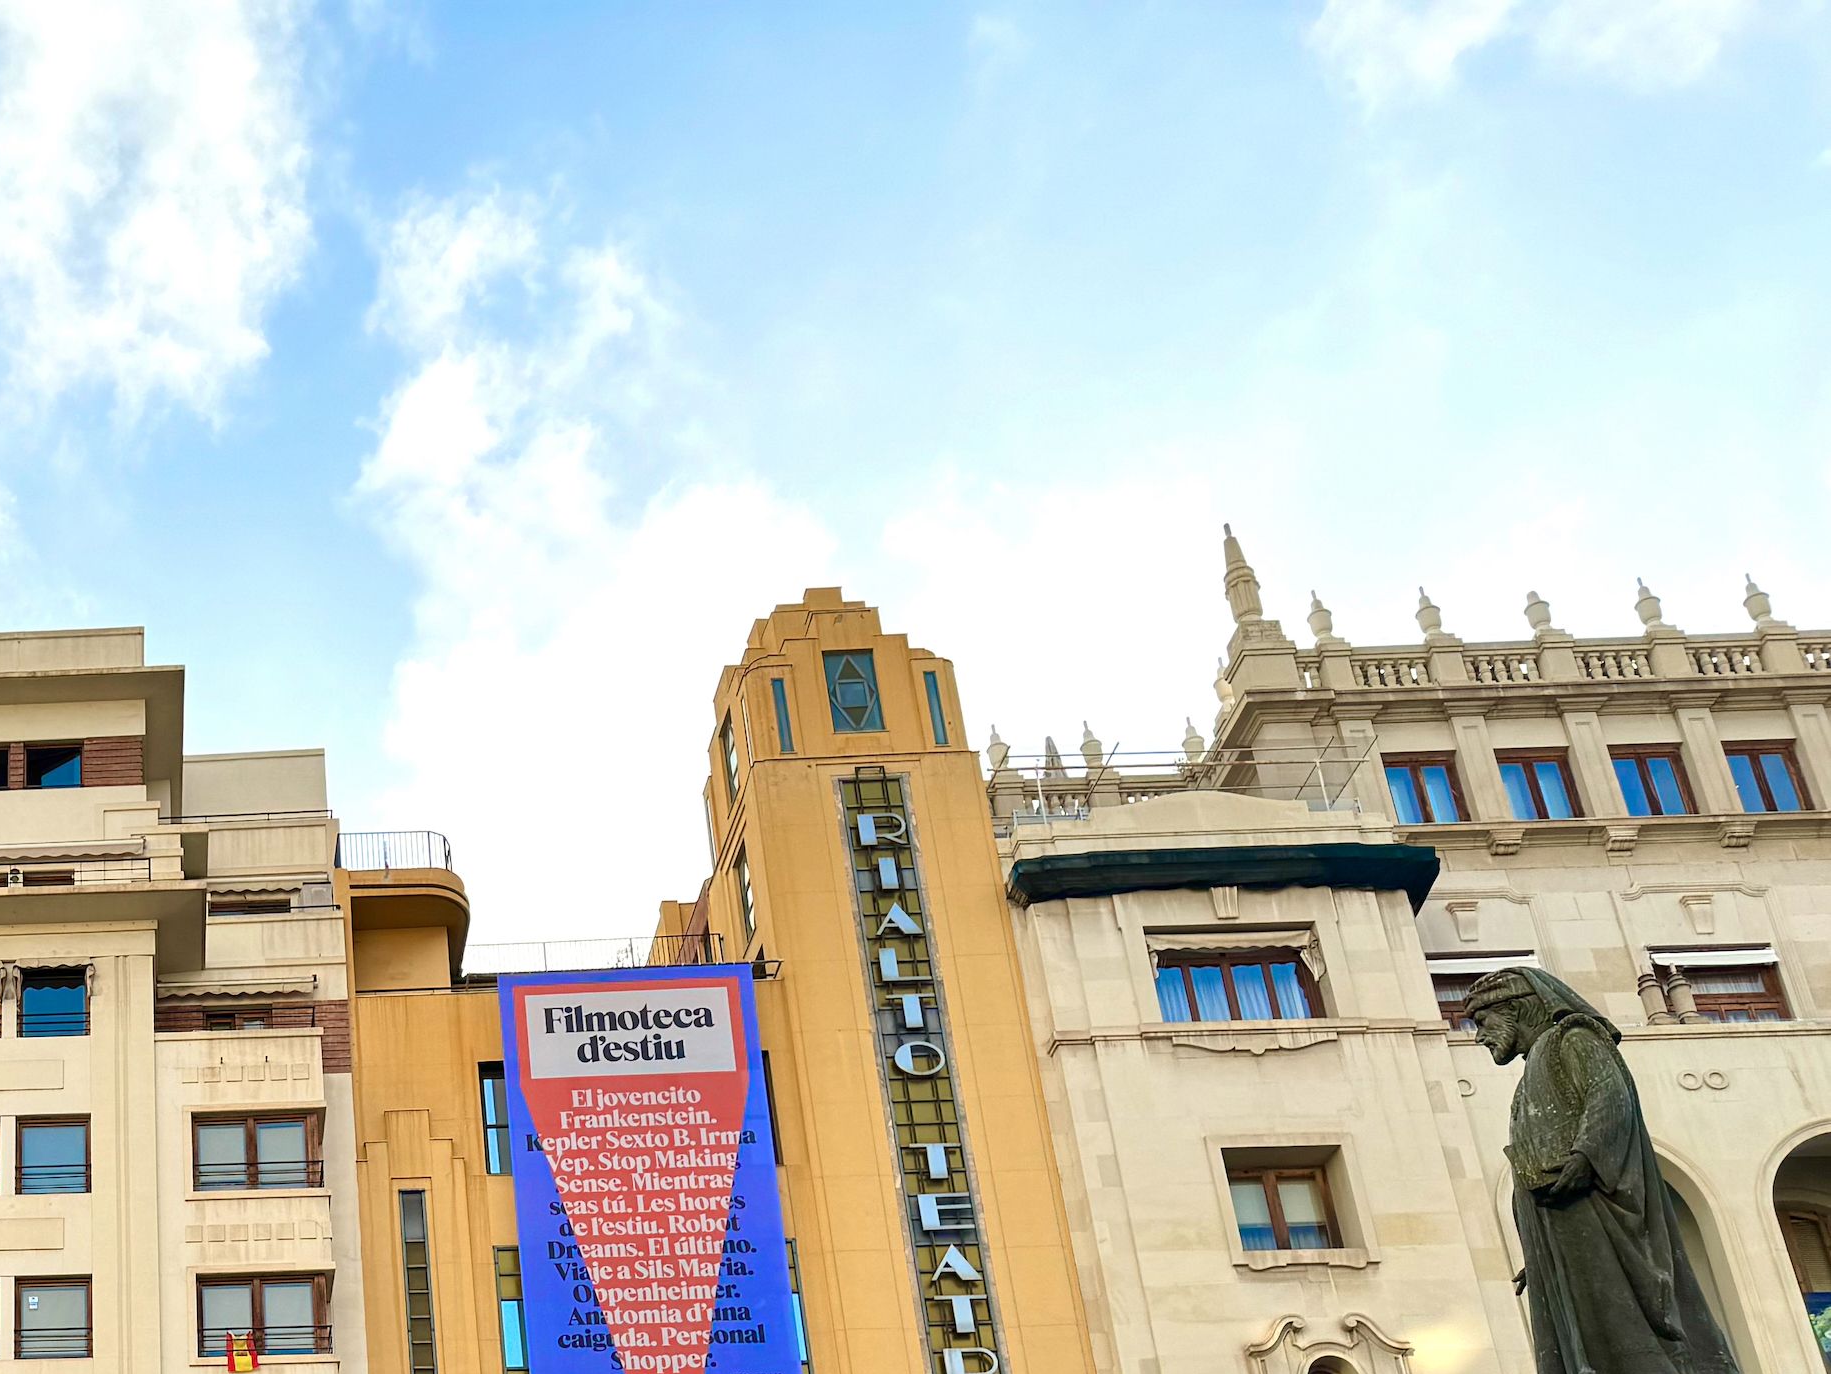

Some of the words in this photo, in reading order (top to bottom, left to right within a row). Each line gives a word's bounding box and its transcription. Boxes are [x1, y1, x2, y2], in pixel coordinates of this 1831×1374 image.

[856, 812, 946, 1076] RIALTO
[543, 1003, 715, 1034] Filmoteca
[577, 1033, 686, 1063] d'estiu
[571, 1089, 593, 1108] El
[597, 1086, 701, 1111] jovencito
[559, 1107, 717, 1130] Frankenstein.
[526, 1133, 602, 1156] Kepler
[606, 1129, 669, 1149] Sexto
[672, 1128, 696, 1147] B.
[700, 1127, 756, 1146] Irma
[546, 1153, 595, 1175] Vep.
[598, 1152, 651, 1174] Stop
[655, 1148, 741, 1170] Making
[556, 1174, 627, 1194] Sense.
[631, 1172, 734, 1191] Mientras
[550, 1198, 598, 1215] seas
[602, 1194, 633, 1214] tú.
[637, 1195, 676, 1213] Les
[680, 1193, 745, 1212] hores
[560, 1218, 588, 1236] de
[668, 1213, 740, 1234] Robot
[548, 1241, 644, 1260] Dreams.
[648, 1237, 670, 1257] El
[674, 1236, 757, 1257] último.
[554, 1262, 613, 1284] Viaje
[616, 1265, 631, 1279] a
[634, 1260, 675, 1280] Sils
[679, 1257, 754, 1278] Maria.
[573, 1282, 741, 1308] Oppenheimer.
[568, 1304, 682, 1326] Anatomia
[686, 1302, 752, 1323] d'una
[557, 1327, 657, 1352] caiguda.
[661, 1323, 766, 1347] Personal
[611, 1350, 717, 1374] Shopper.
